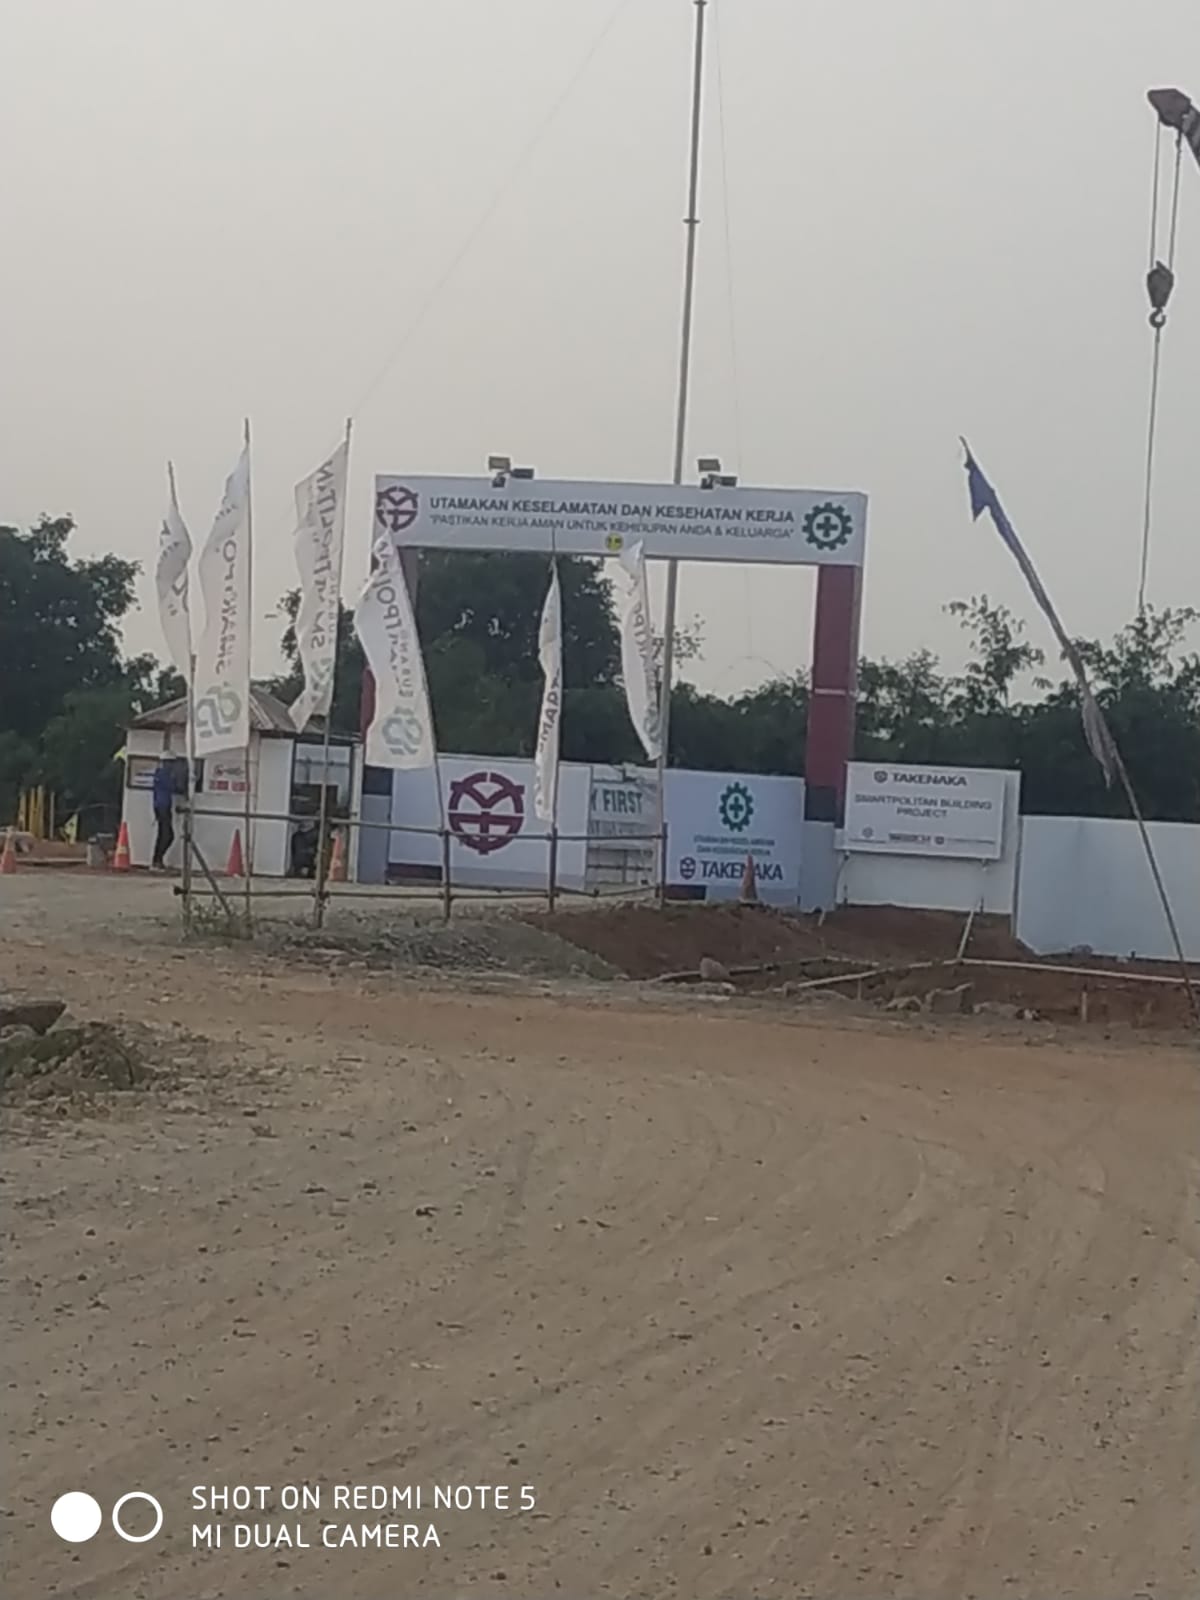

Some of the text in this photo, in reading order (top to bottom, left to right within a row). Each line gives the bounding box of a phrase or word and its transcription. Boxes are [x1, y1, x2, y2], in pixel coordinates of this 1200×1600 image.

[430, 498, 795, 523] UTAMAKAN KESELAMATAN DAN KESEHATAN KERJA
[492, 516, 529, 528] KERJA
[892, 772, 968, 786] TAKENAKA
[602, 788, 643, 814] FIRST
[896, 807, 947, 818] PROJECT
